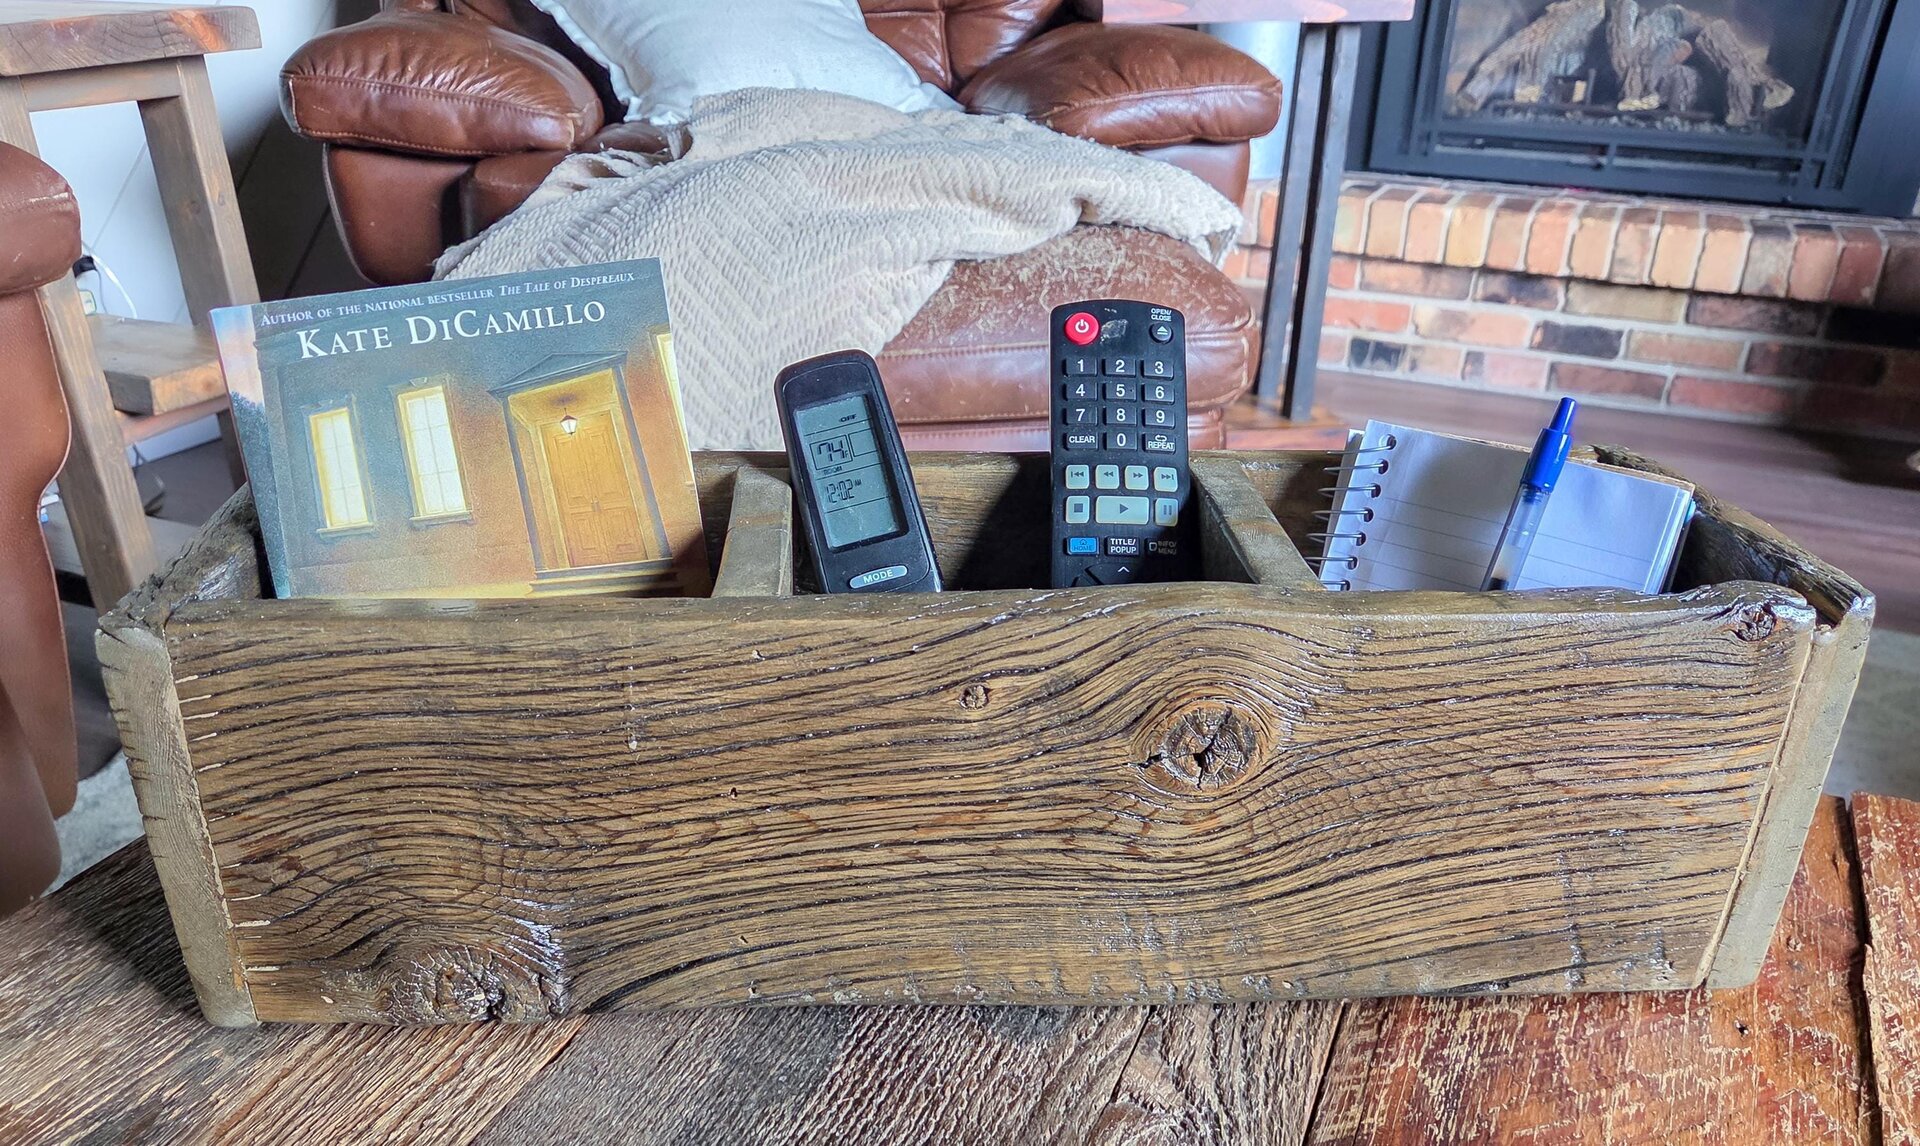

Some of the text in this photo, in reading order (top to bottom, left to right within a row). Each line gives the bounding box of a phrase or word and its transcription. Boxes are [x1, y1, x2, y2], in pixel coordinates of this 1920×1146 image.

[260, 272, 635, 327] AUTHOR OF THE NATIONAL BESTSELLER THE TALE OF DESPEREAUX
[1150, 314, 1172, 322] CLOSE
[297, 327, 392, 359] KATE
[1077, 359, 1084, 372] 1
[1115, 359, 1125, 373] 2
[1154, 361, 1164, 374] 3
[1076, 383, 1085, 397] 4
[1116, 384, 1125, 397] 5
[1155, 386, 1165, 399] 6
[1076, 408, 1085, 421] 7
[1116, 408, 1126, 422] 8
[1156, 410, 1165, 423] 9
[1068, 435, 1096, 443] CLEAR
[1148, 441, 1175, 450] REPEAT
[1110, 538, 1136, 546] TITLE/
[1110, 546, 1137, 554] POPUP
[863, 568, 894, 585] MODE
